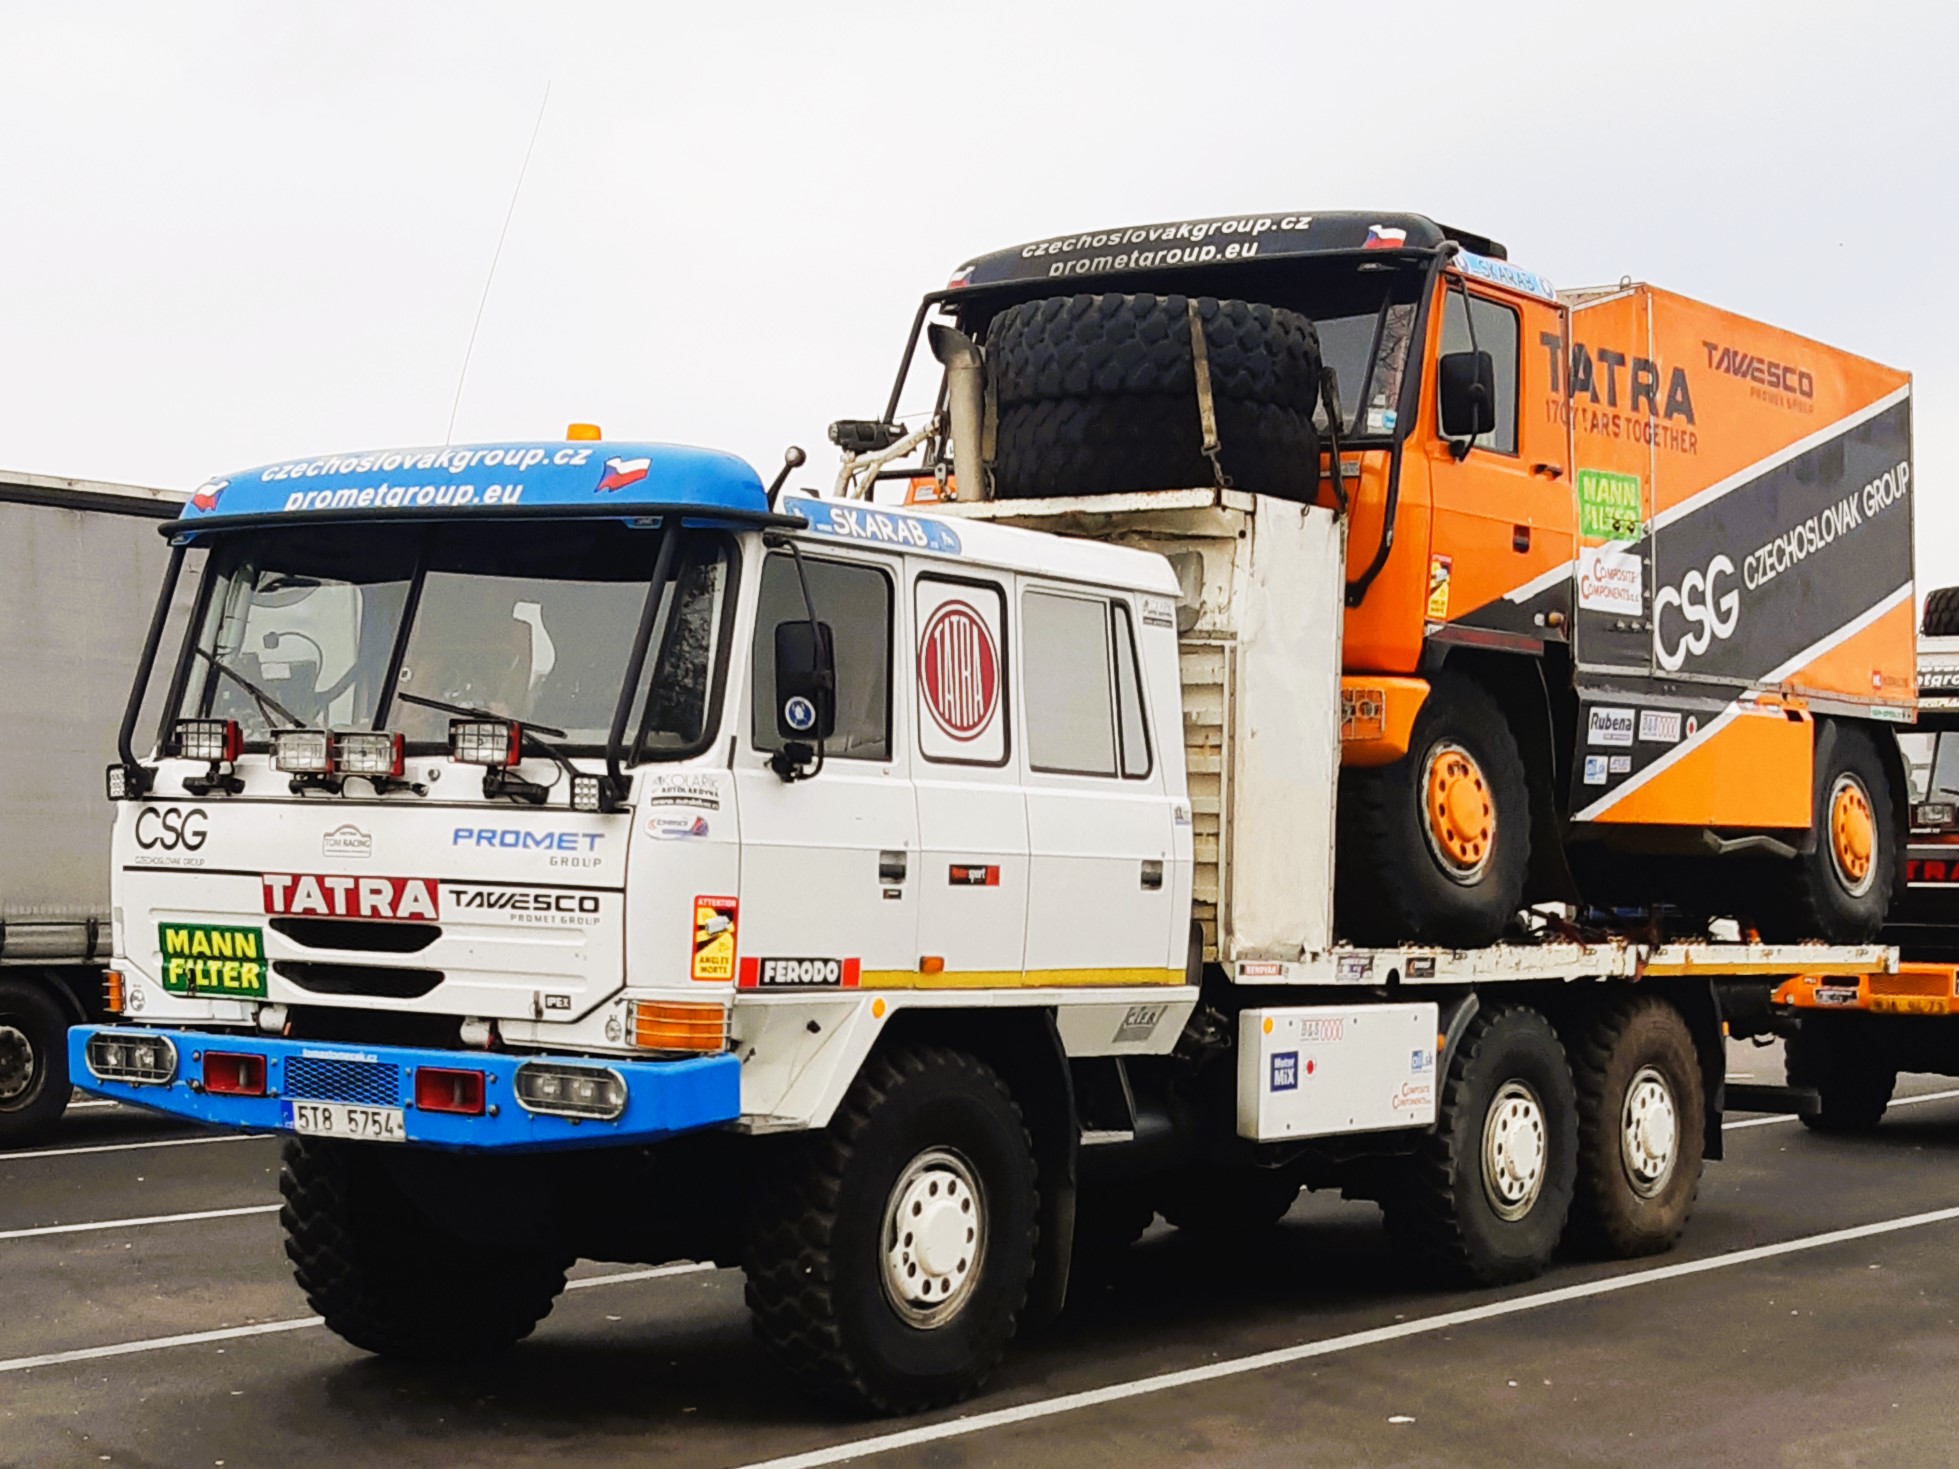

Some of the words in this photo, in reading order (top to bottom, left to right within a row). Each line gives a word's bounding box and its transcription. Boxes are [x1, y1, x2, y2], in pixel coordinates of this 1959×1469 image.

[1021, 215, 1313, 258] czechoslovakgroup.cz
[1049, 240, 1259, 278] prometgroup.eu
[1539, 330, 1696, 426] TATRA
[261, 448, 593, 483] czechoslovakgroup.cz
[283, 483, 523, 512] prometgroup.eu
[830, 508, 928, 547] SKARAB
[1744, 492, 1862, 590] CZECHOSLOVAK
[1863, 461, 1910, 518] GROUP
[1654, 554, 1740, 672] CSG
[934, 615, 984, 728] TATRA
[1591, 712, 1633, 732] Rubena
[135, 807, 208, 851] CSG
[452, 828, 605, 851] PROMET
[549, 856, 602, 868] GROUP
[263, 873, 438, 919] TATRA
[510, 913, 556, 923] PROMET
[560, 915, 600, 926] GROUP
[165, 928, 257, 958] MANN
[764, 960, 839, 983] FERODO
[298, 1105, 333, 1131] 5T8
[347, 1109, 394, 1135] 5754
